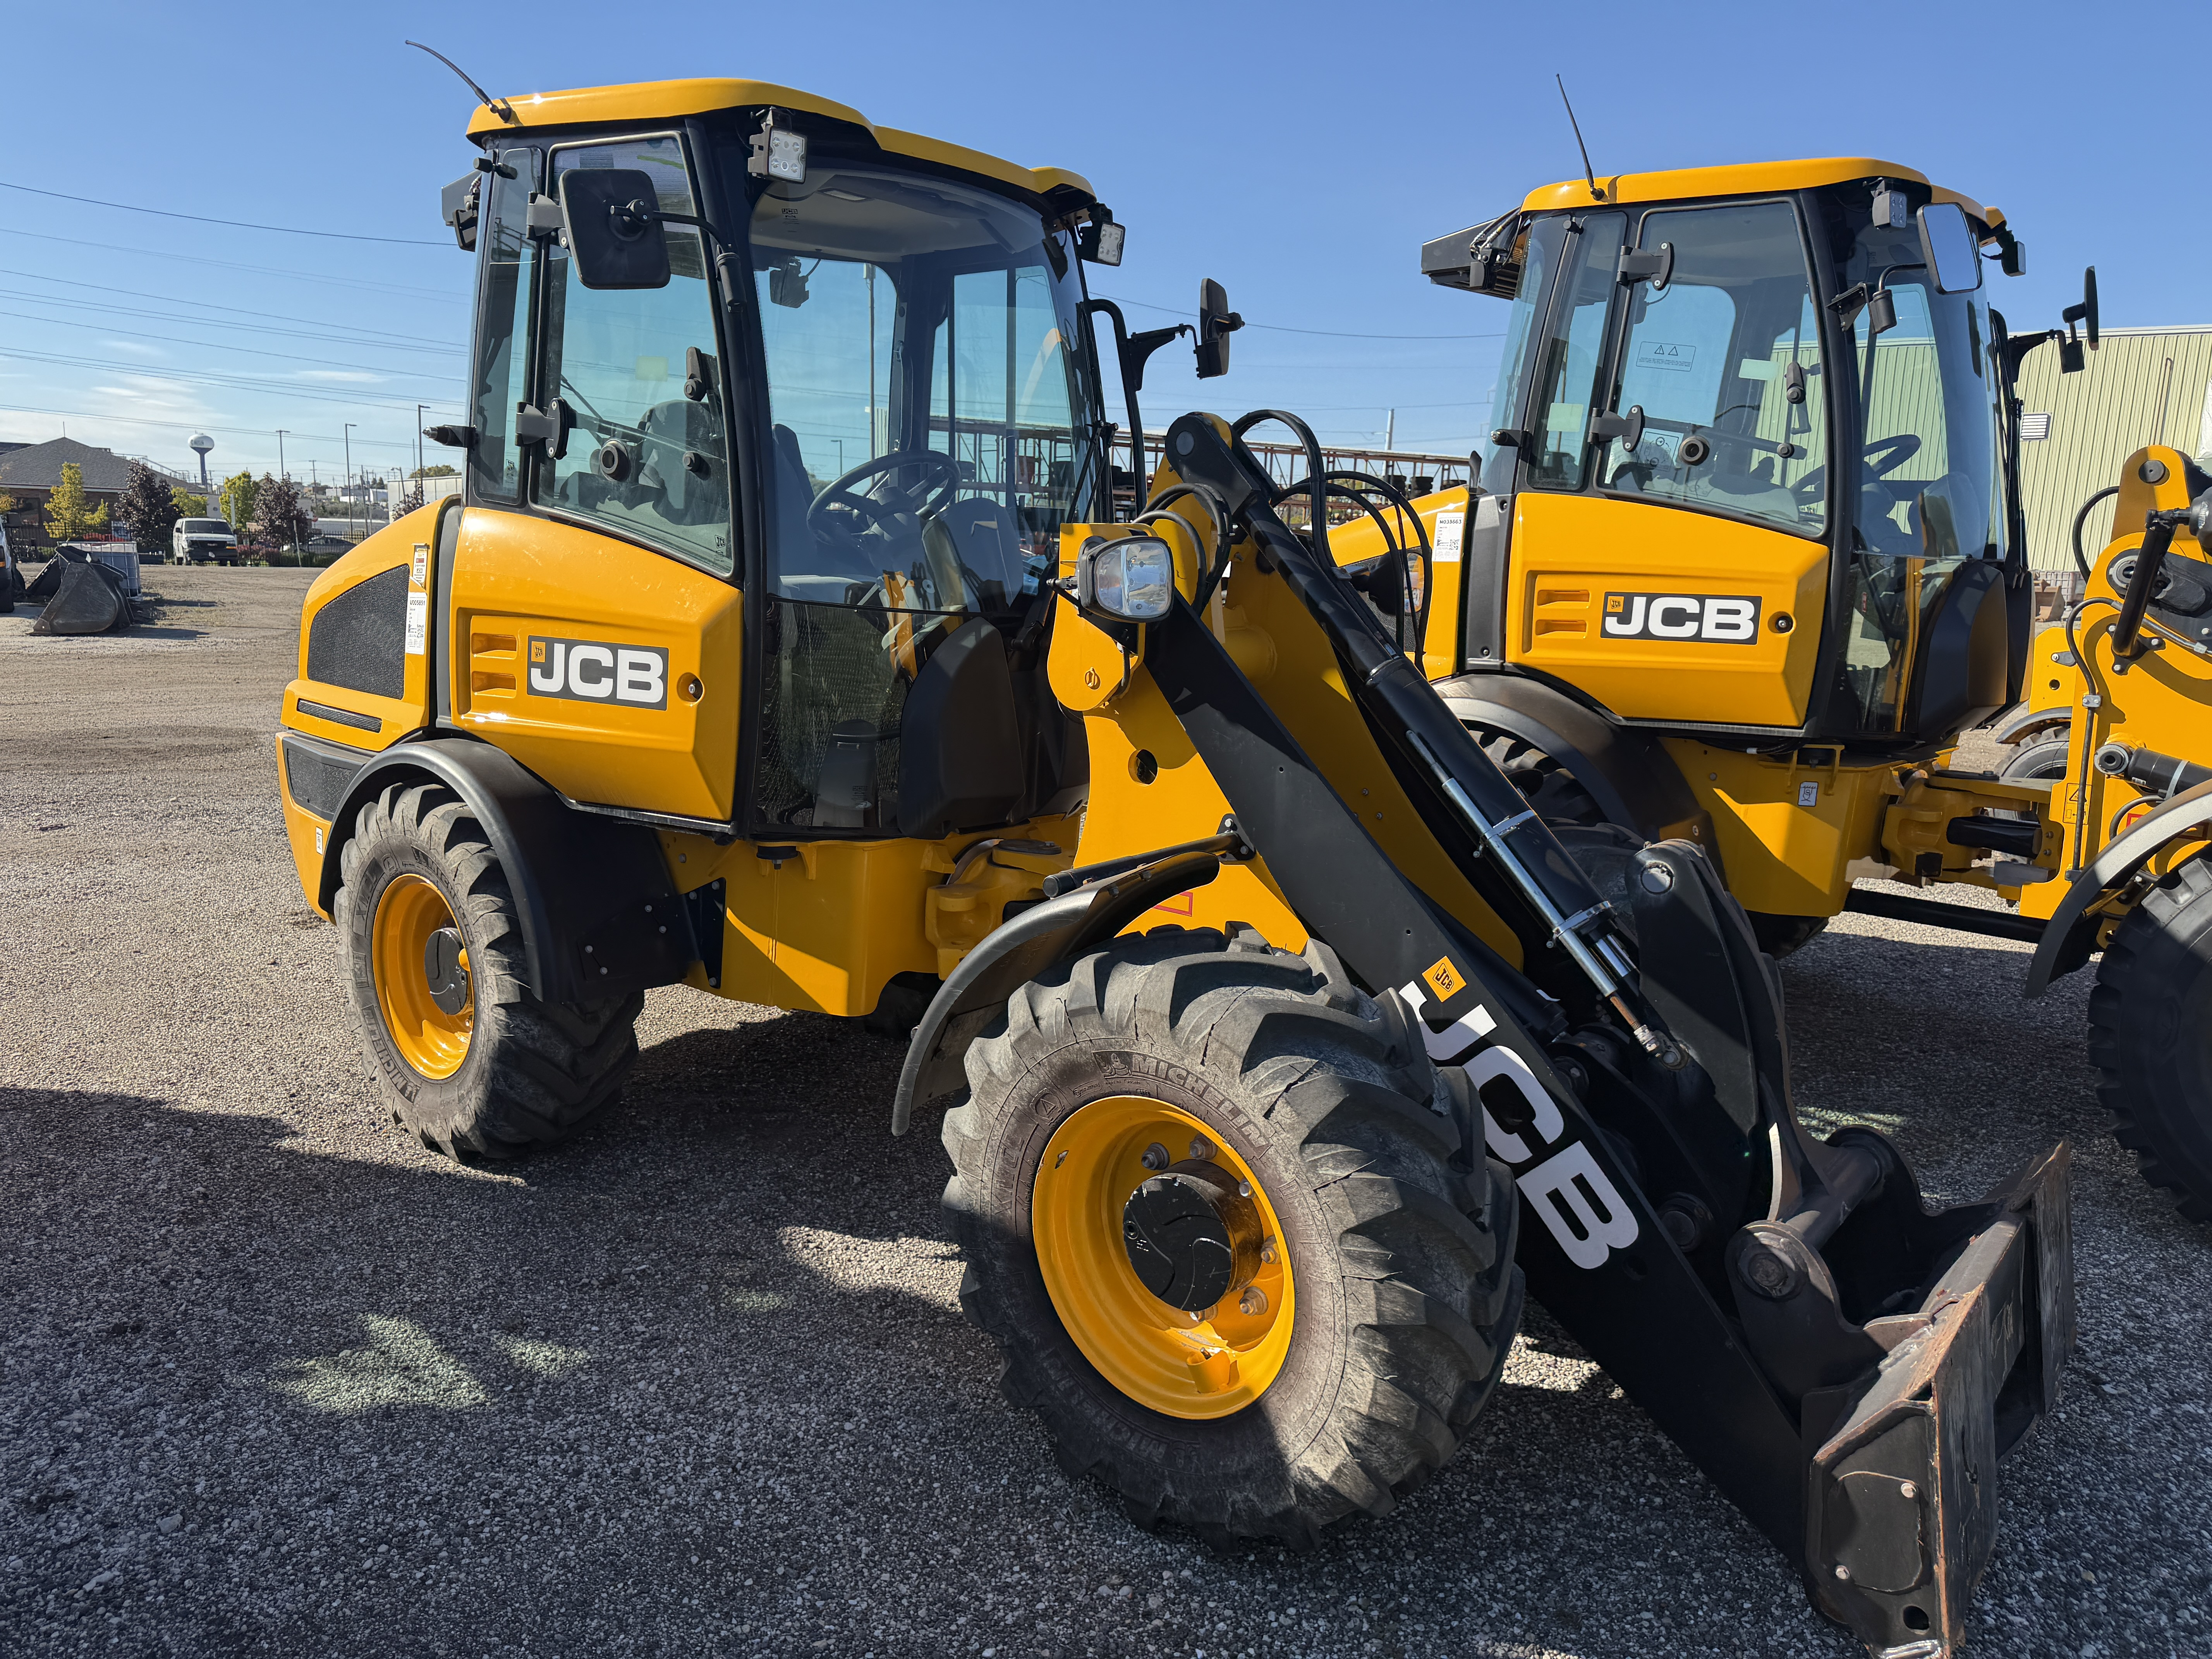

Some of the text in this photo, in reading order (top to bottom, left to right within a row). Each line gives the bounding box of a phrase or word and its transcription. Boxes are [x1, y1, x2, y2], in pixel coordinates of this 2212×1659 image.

[1605, 596, 1755, 641] JCB
[530, 643, 664, 703] JCB
[1434, 967, 1453, 990] JCB
[1131, 1053, 1267, 1148] MICHELIN
[1399, 981, 1638, 1269] JCB
